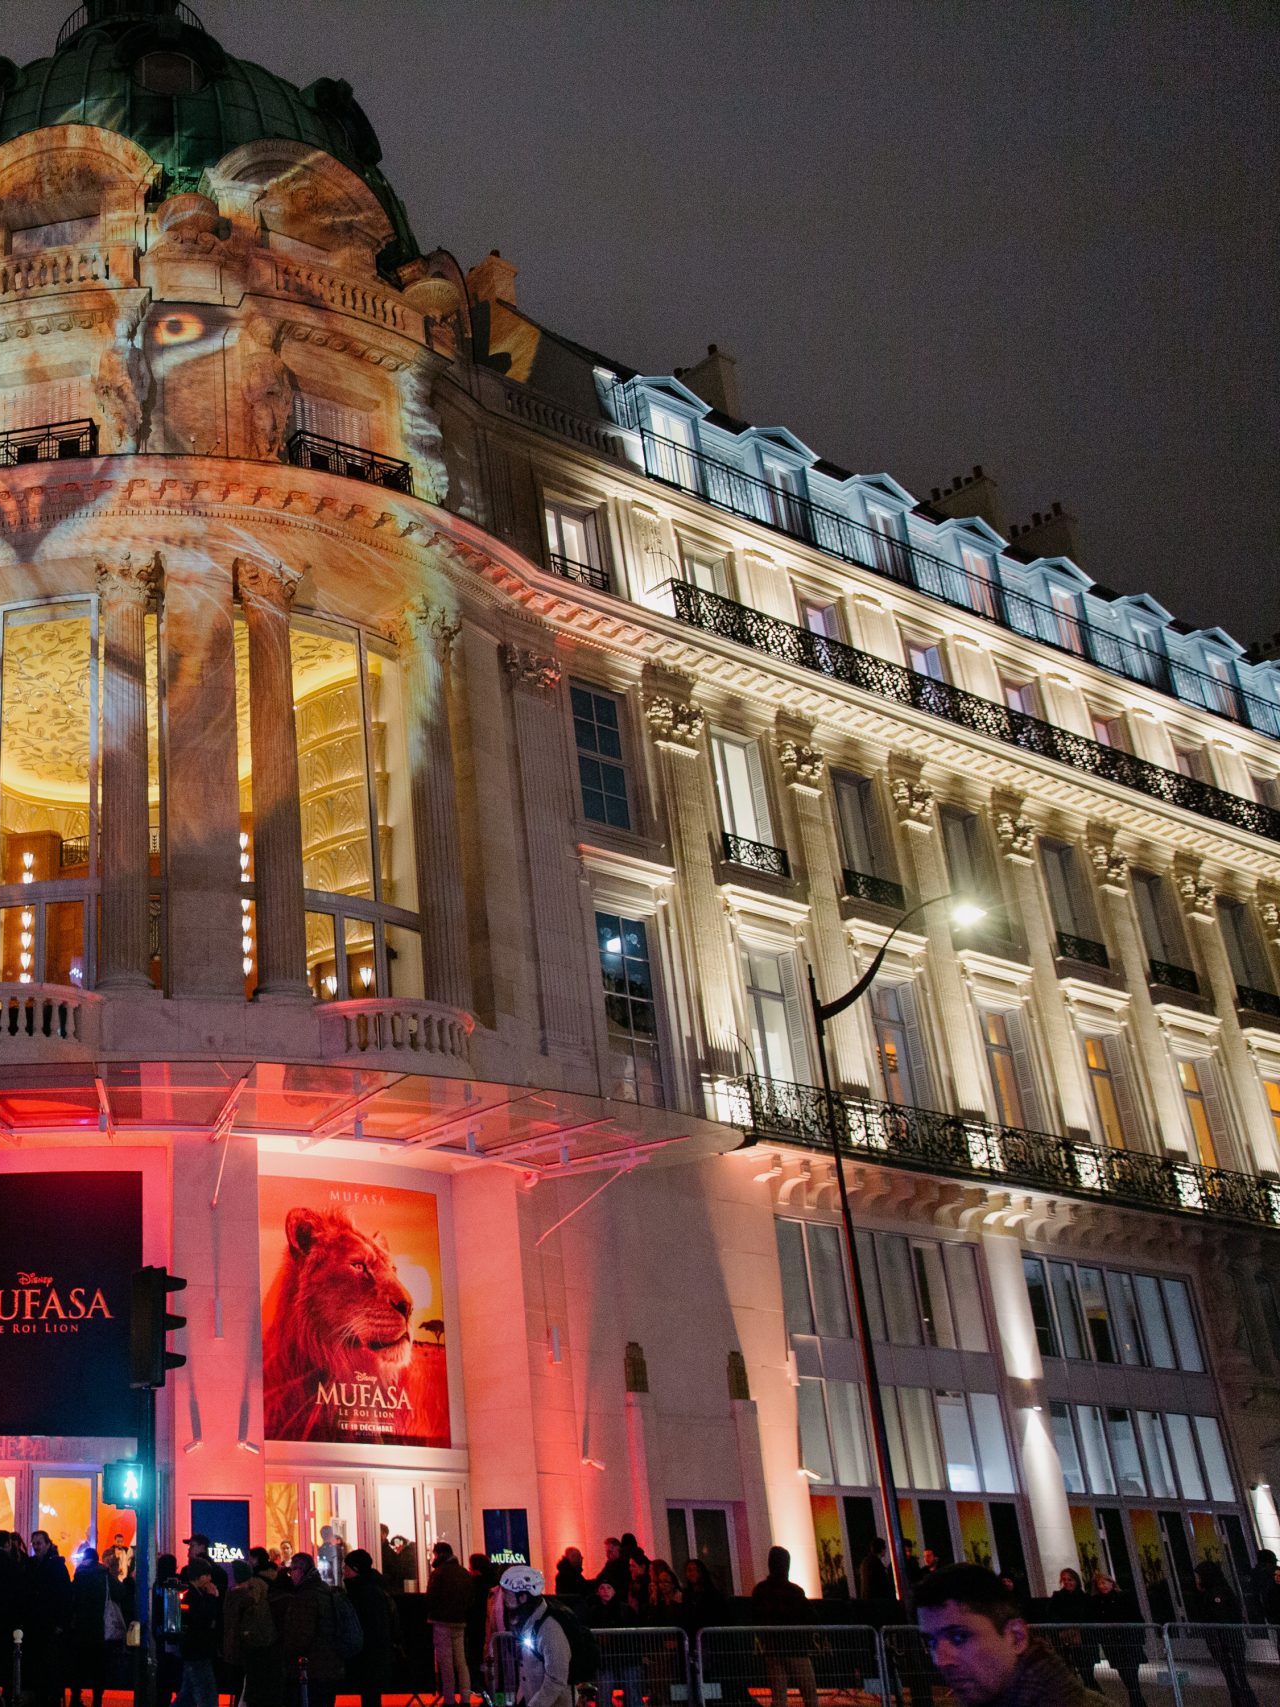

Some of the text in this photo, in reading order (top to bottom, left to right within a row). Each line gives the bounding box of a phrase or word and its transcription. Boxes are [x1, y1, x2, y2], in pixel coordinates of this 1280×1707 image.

[329, 1190, 386, 1206] MUFASA
[315, 1381, 413, 1410] MUFASA
[490, 1552, 527, 1564] MUFASA
